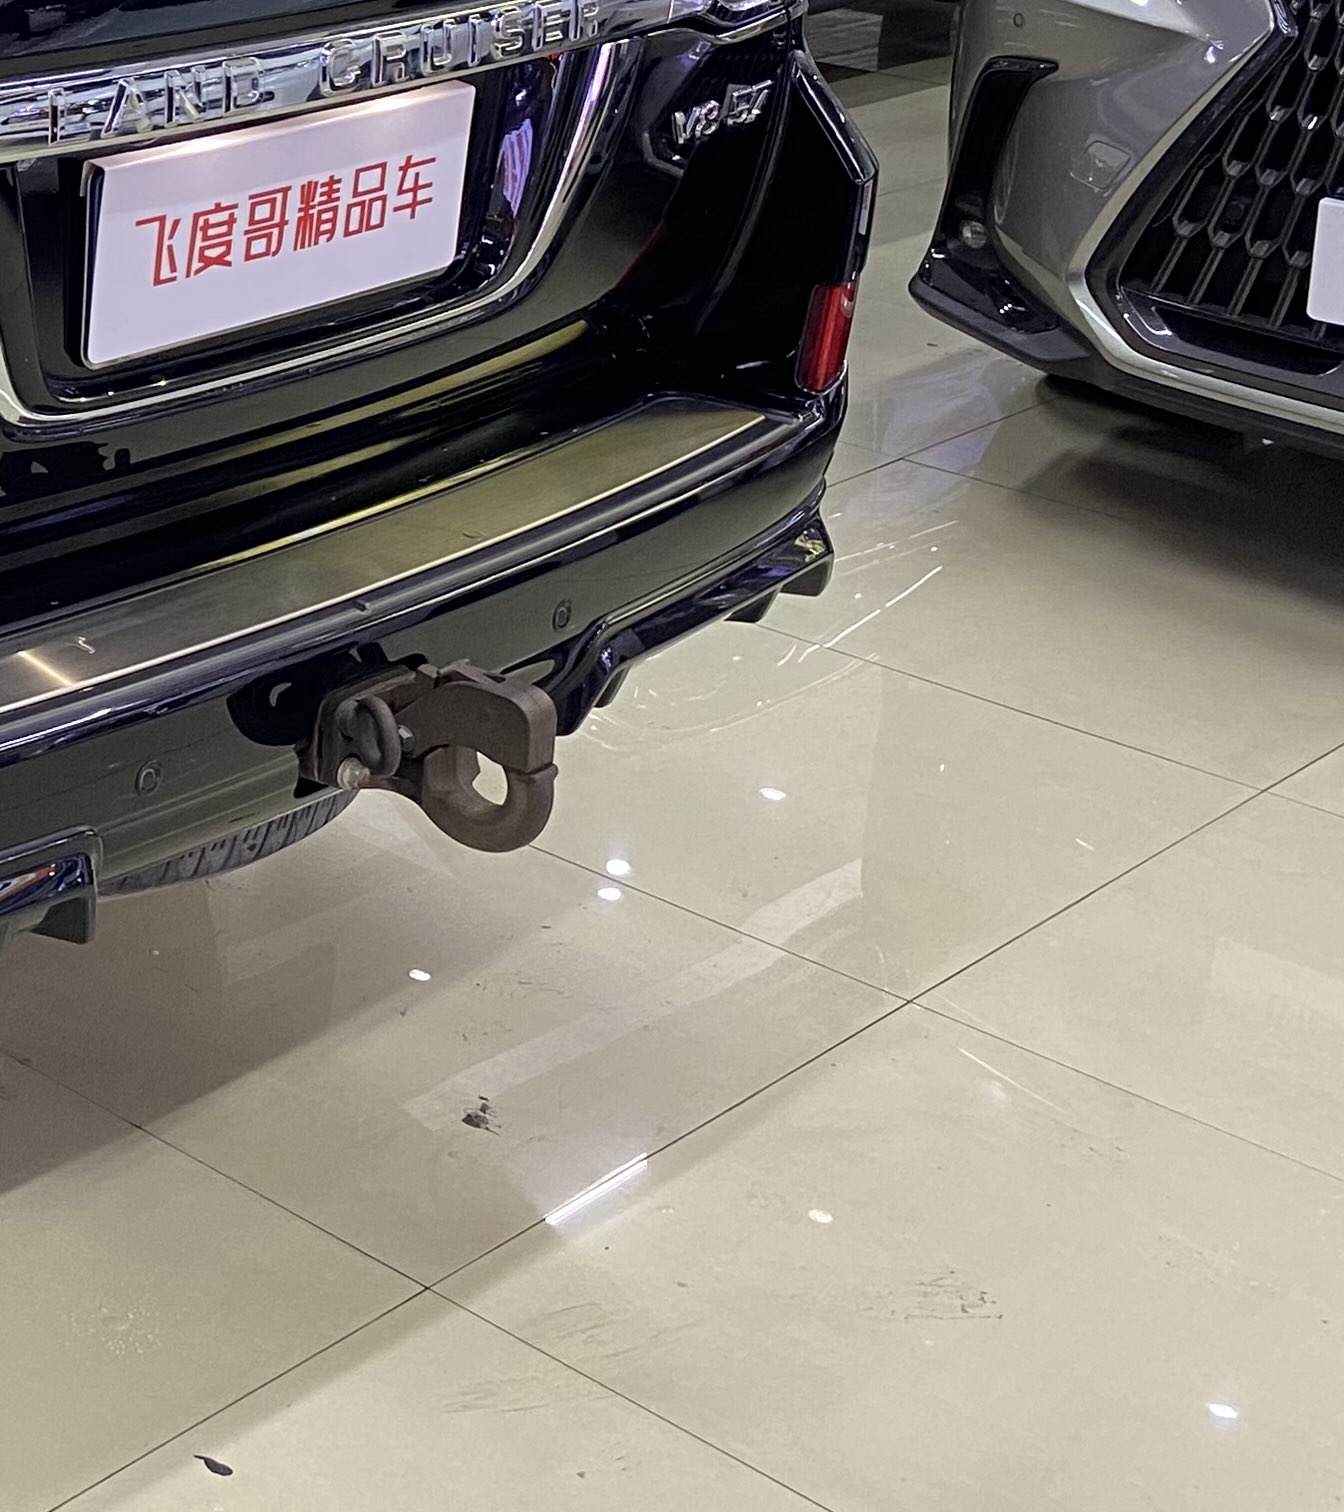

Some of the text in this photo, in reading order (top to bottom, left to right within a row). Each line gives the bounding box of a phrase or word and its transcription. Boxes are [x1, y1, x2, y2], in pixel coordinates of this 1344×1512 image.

[47, 56, 267, 146] LAND
[672, 99, 720, 145] V8
[134, 153, 438, 287] 飞度哥精品车
